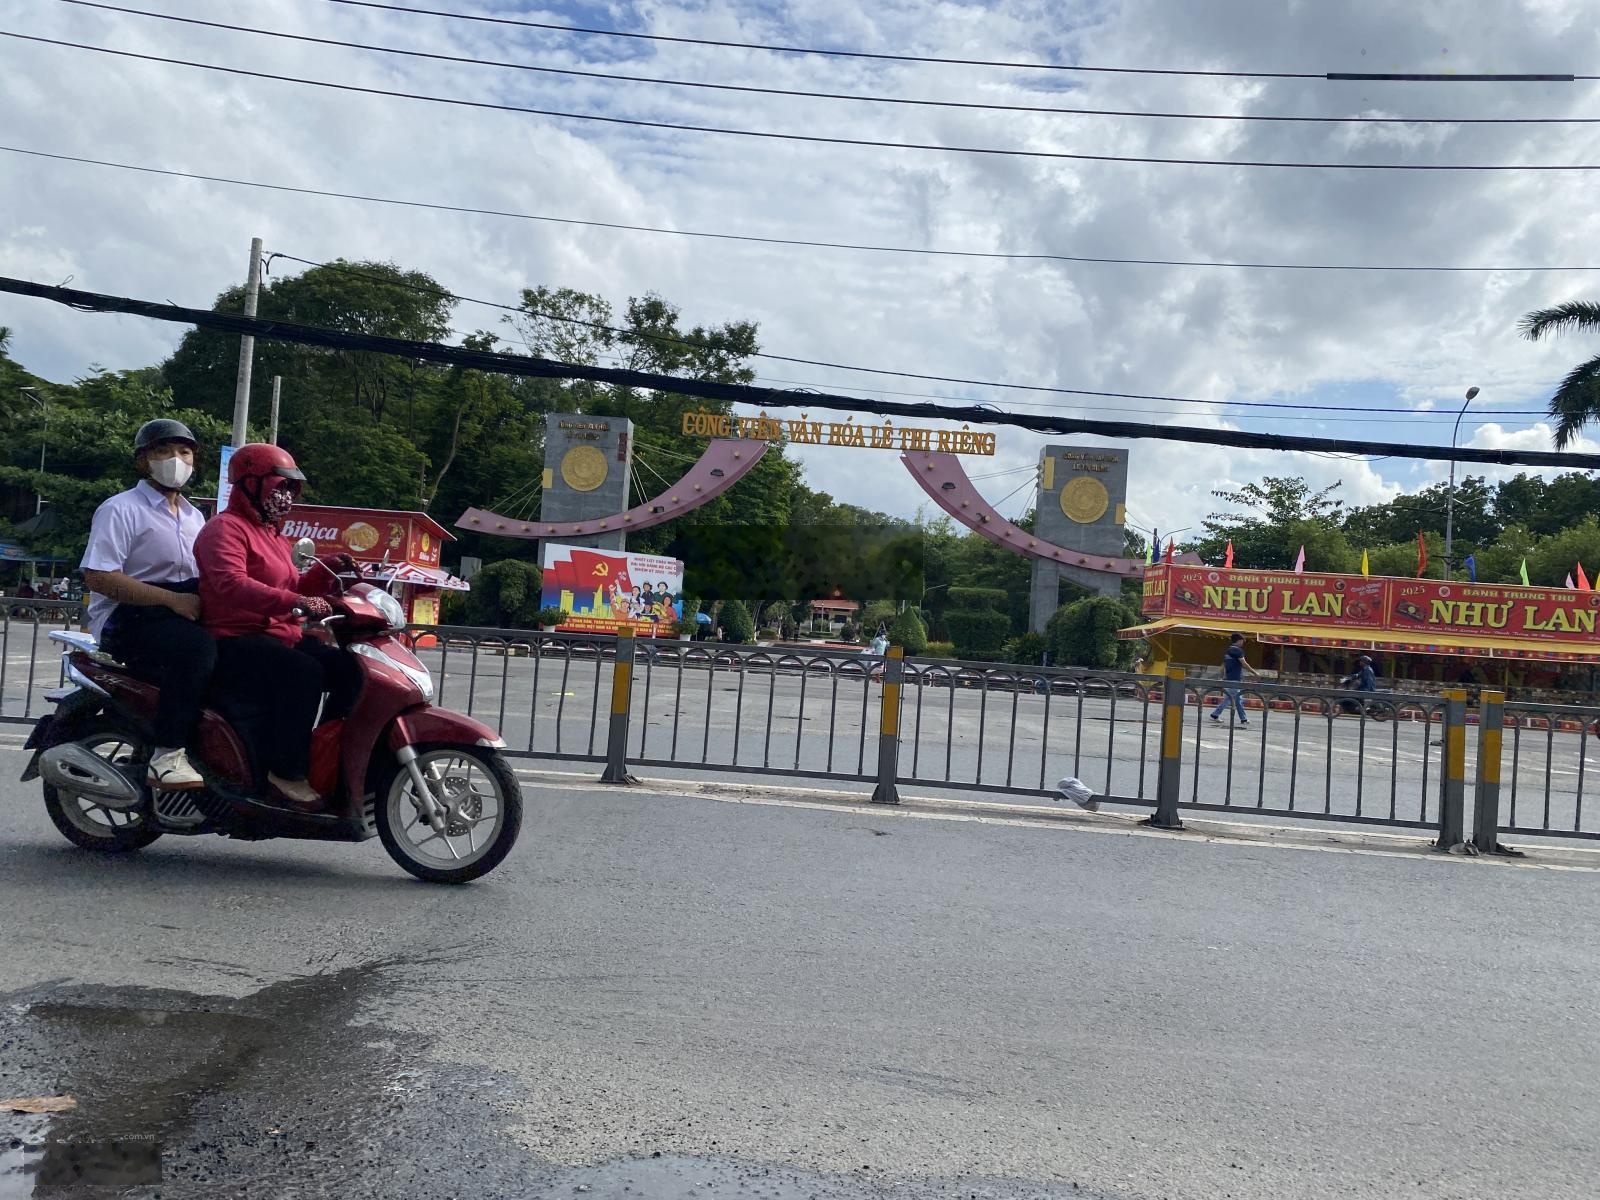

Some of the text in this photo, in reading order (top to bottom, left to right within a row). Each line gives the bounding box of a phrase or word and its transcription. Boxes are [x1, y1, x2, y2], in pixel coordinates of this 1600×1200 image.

[682, 406, 731, 437] CÔNG
[737, 410, 782, 439] VIÊN
[787, 412, 823, 443] VĂN
[828, 415, 866, 446] HÓA
[870, 419, 893, 448] LÊ
[937, 424, 996, 455] RIÊNG
[280, 520, 339, 541] Bibica
[1182, 572, 1202, 583] 2025
[1263, 576, 1301, 585] TRUNG
[1202, 585, 1345, 617] NHƯ LAN
[1400, 585, 1425, 596] 2025
[1503, 591, 1546, 600] TRUNG
[1428, 599, 1598, 633] NHƯ LAN
